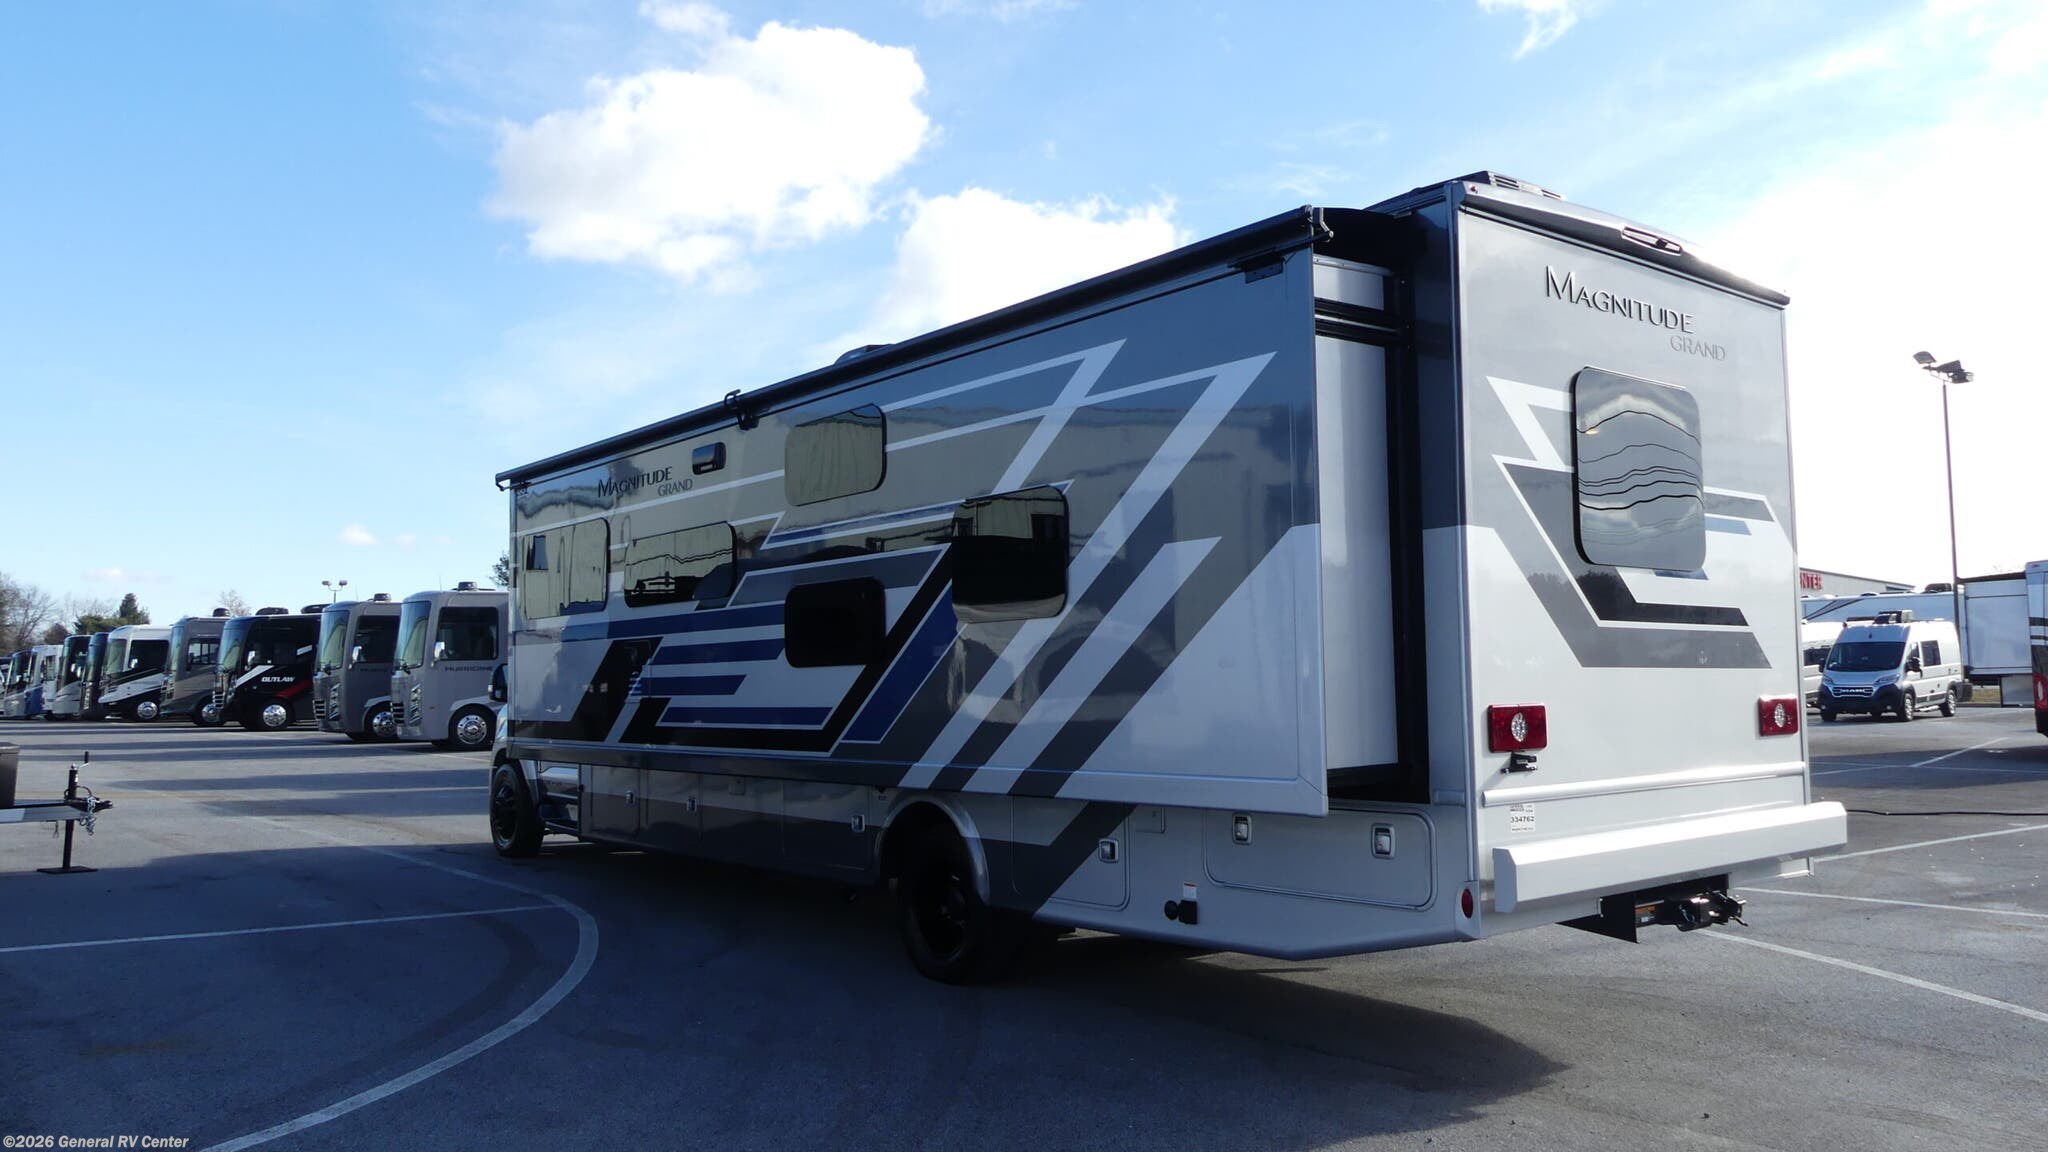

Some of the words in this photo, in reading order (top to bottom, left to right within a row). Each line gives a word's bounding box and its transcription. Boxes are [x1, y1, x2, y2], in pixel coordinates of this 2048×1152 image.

[1545, 265, 1694, 334] MAGNITUDE
[1669, 335, 1726, 361] GRAND
[597, 466, 673, 498] MAGNITUDE
[657, 478, 693, 497] GRAND
[1800, 571, 1824, 591] NTER
